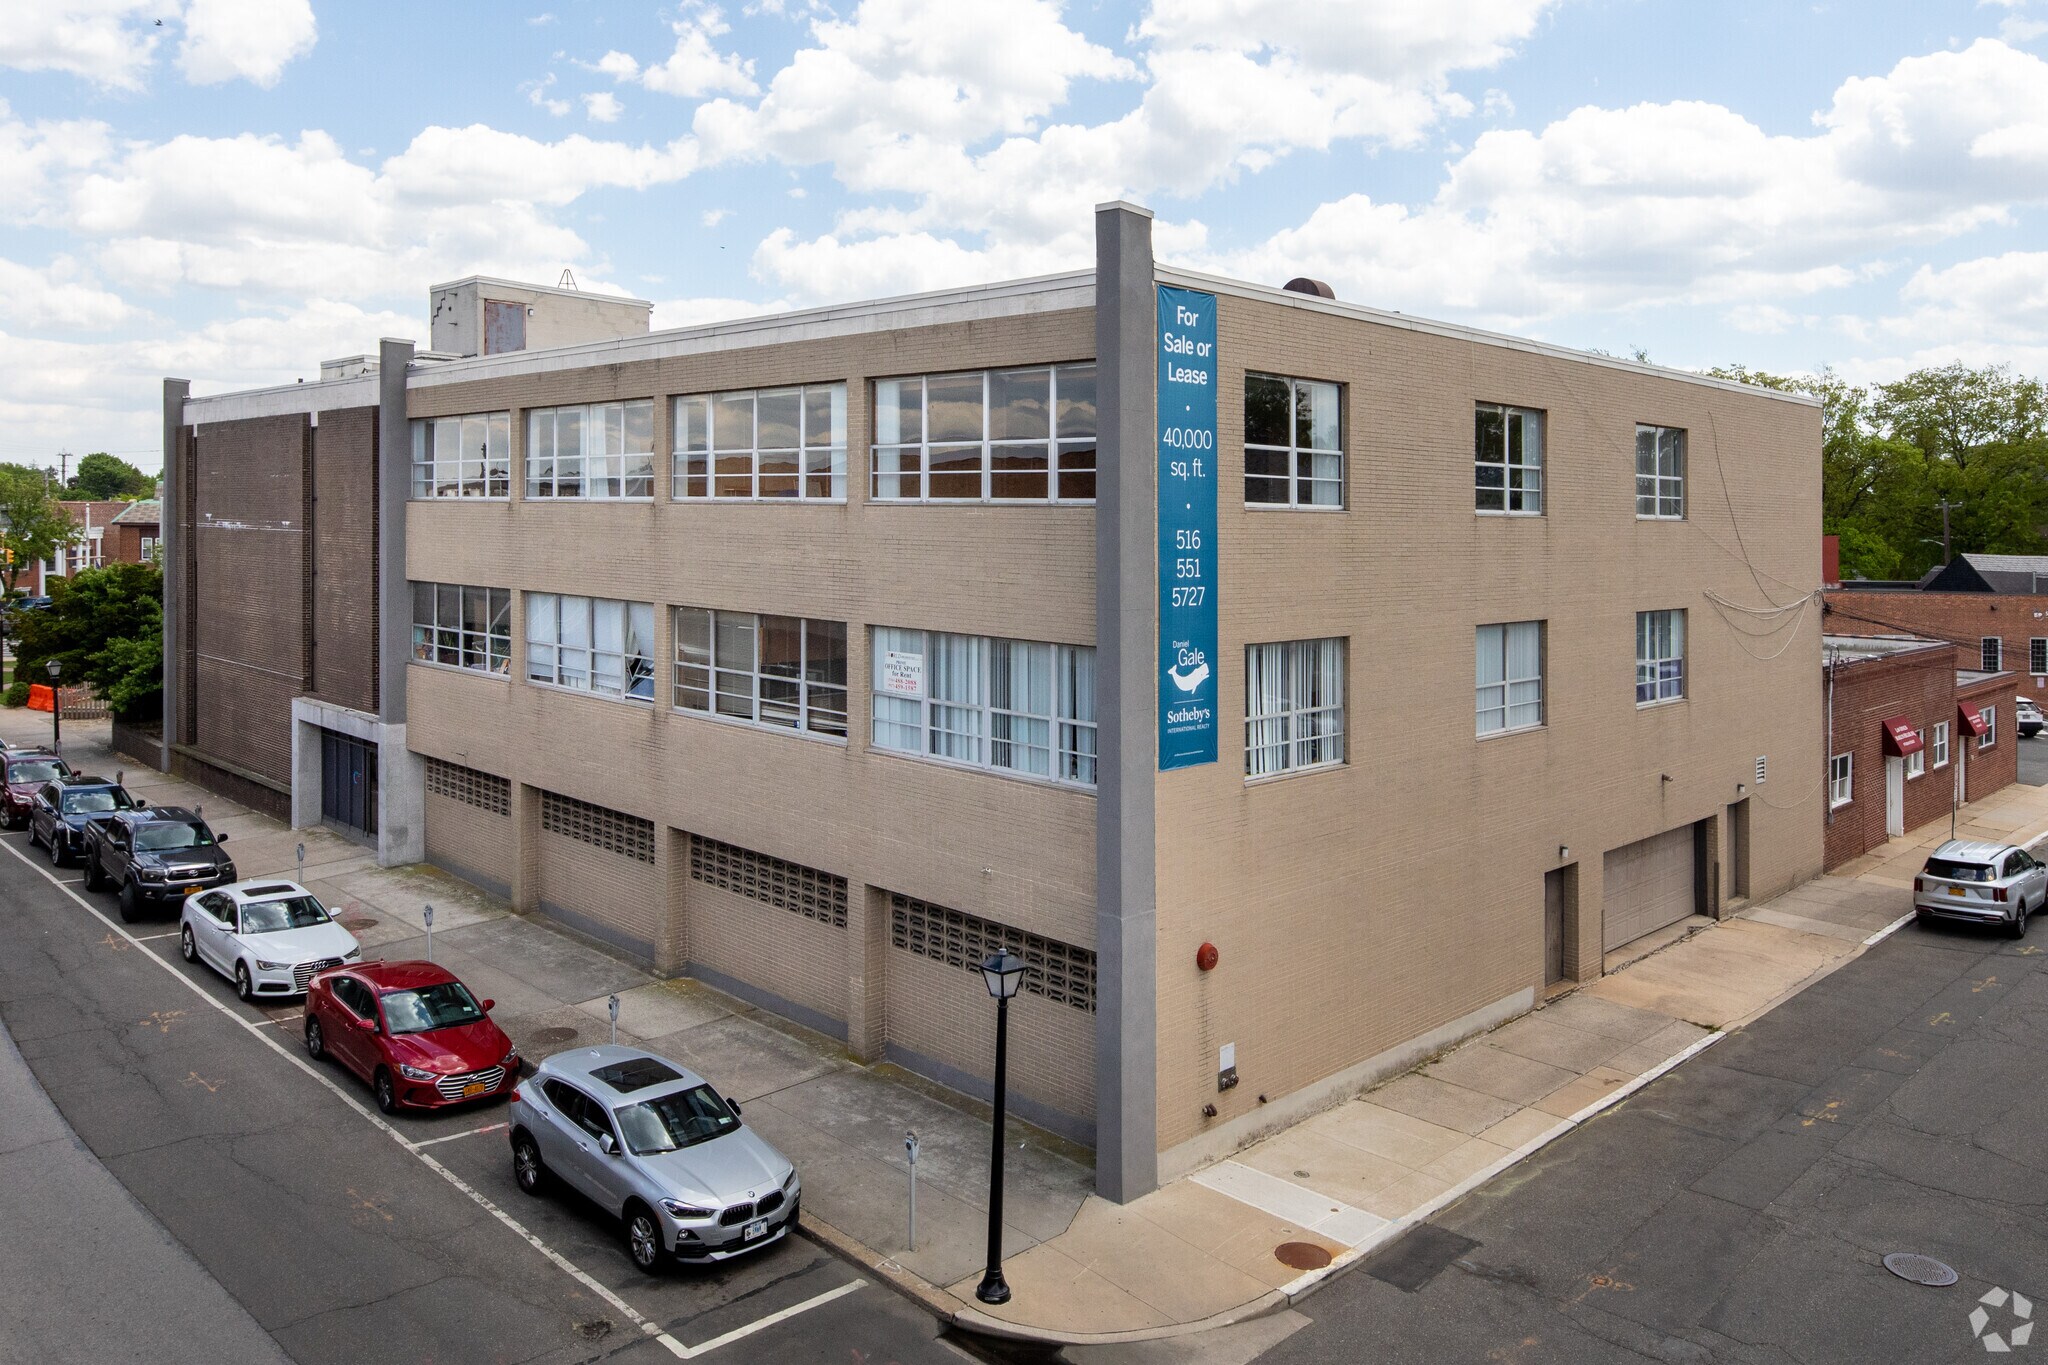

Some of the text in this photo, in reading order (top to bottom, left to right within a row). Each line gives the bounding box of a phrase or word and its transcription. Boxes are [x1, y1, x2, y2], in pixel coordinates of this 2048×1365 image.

[1177, 305, 1199, 327] For
[1164, 332, 1212, 357] Sale or
[1168, 361, 1208, 385] Lease
[1163, 427, 1212, 449] 40,000
[1170, 457, 1206, 481] sq. ft.
[1176, 529, 1201, 549] 516
[1176, 558, 1201, 578] 551
[1172, 586, 1205, 607] 5727
[1172, 640, 1190, 648] Daniel
[1178, 648, 1204, 666] Gale
[1168, 706, 1210, 723] Sotheby's
